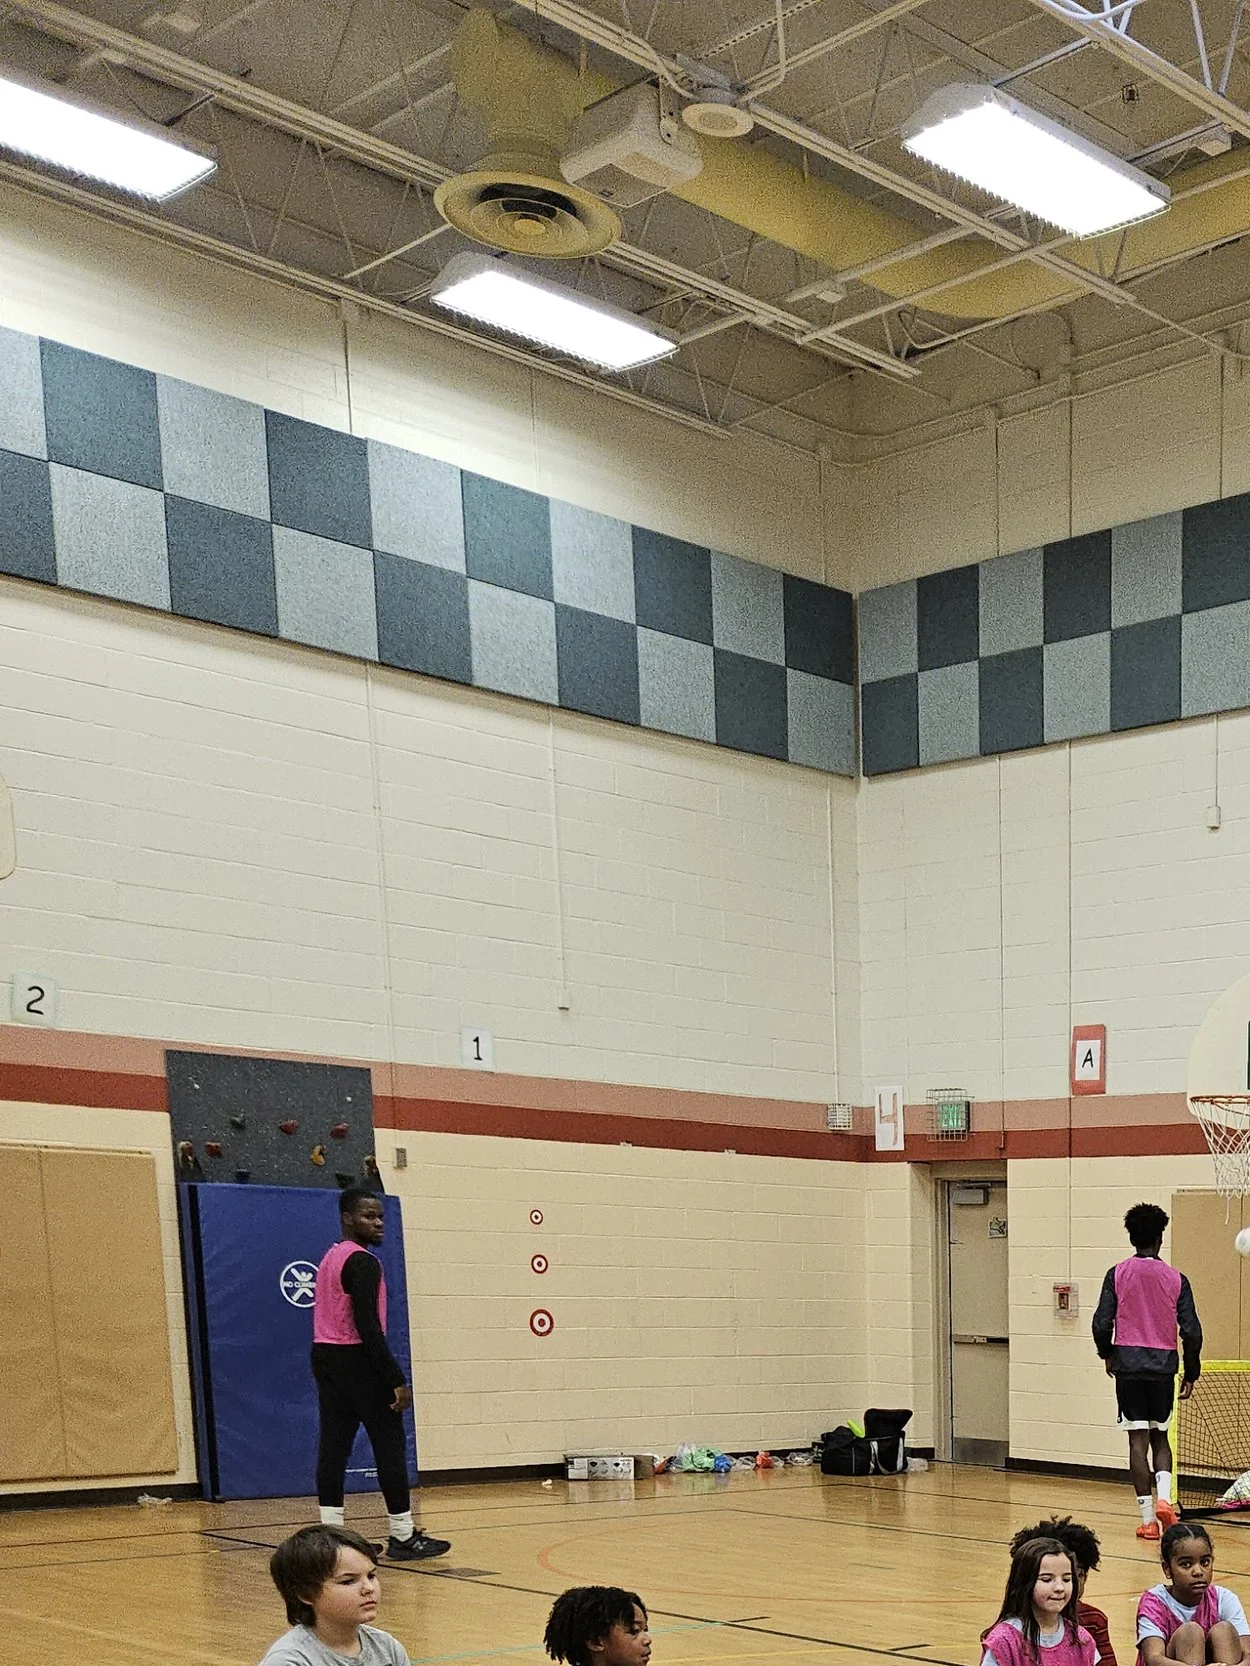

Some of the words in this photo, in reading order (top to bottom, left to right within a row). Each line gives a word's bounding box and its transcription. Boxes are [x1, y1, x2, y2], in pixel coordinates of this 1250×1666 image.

[26, 985, 45, 1015] 2
[472, 1036, 483, 1061] 1
[1081, 1047, 1094, 1068] A
[878, 1092, 898, 1146] 4
[941, 1103, 962, 1129] EXIT
